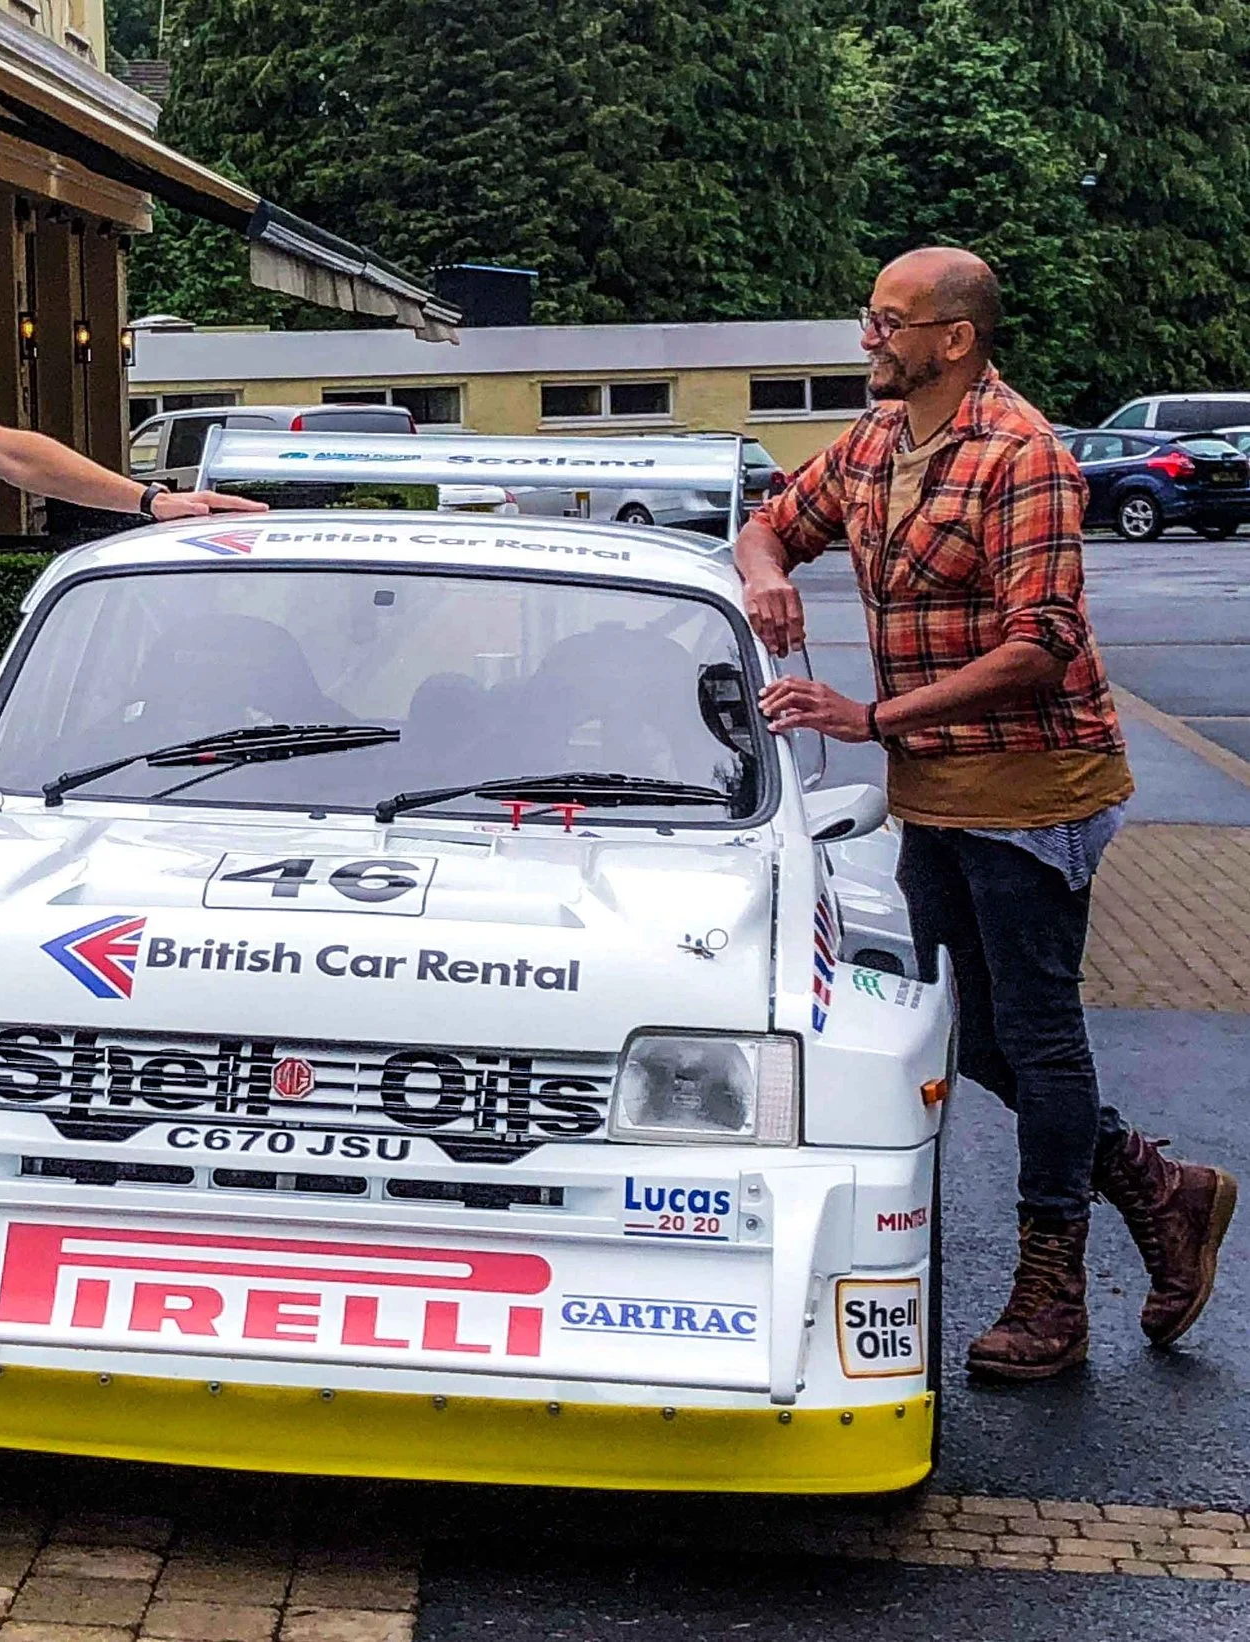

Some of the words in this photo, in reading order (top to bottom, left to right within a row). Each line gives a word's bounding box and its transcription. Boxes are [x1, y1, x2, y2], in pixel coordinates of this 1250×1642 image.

[447, 455, 655, 468] Scotland
[266, 532, 397, 544] British
[409, 534, 490, 547] Car
[495, 538, 631, 561] Rental
[221, 858, 421, 904] 46
[145, 937, 302, 975] British
[315, 944, 408, 981] Car
[416, 950, 580, 992] Rental
[276, 1062, 310, 1095] MG
[379, 1050, 608, 1138] Oils
[167, 1127, 296, 1154] C670
[306, 1132, 412, 1162] JSU
[624, 1176, 730, 1215] Lucas
[561, 1301, 756, 1335] GARTRAC
[844, 1299, 918, 1328] Shell
[855, 1330, 912, 1360] Oils
